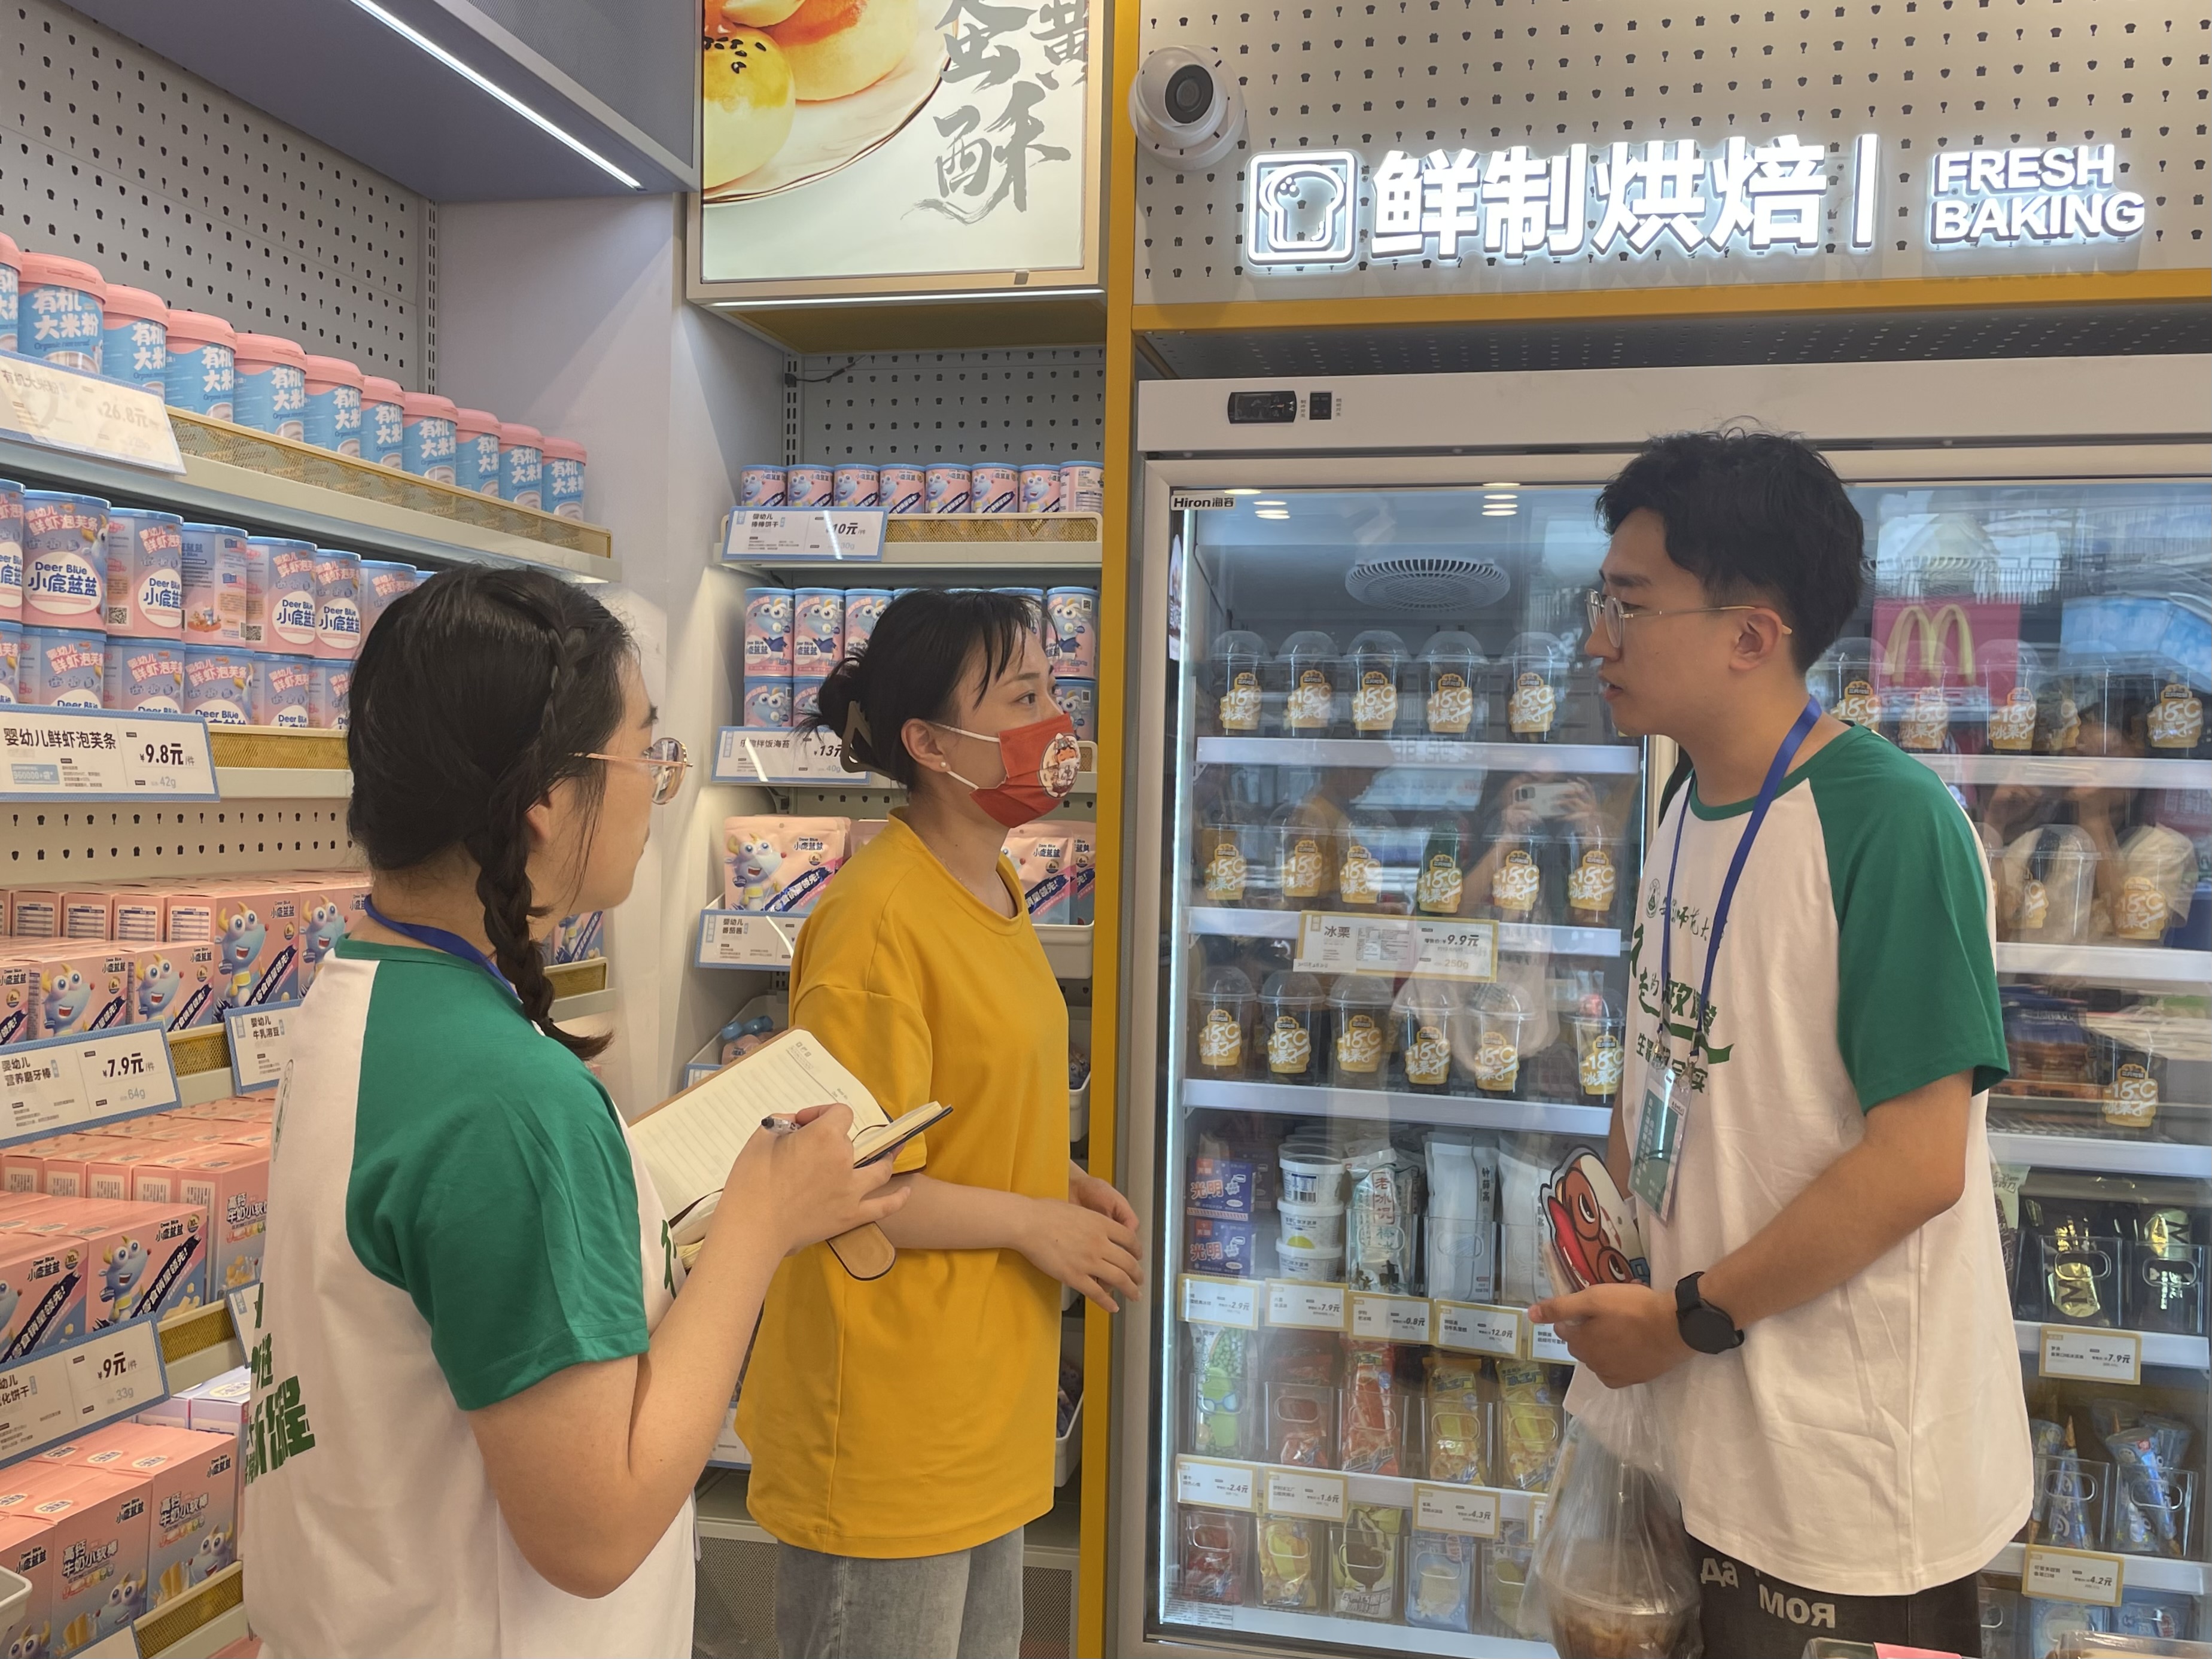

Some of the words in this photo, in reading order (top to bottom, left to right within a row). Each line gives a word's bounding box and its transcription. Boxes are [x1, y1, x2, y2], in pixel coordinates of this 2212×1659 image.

[900, 81, 1072, 226] 酥
[1933, 144, 2115, 196] FRESH
[1370, 136, 1827, 260] 鲜制烘焙
[1931, 192, 2146, 244] BAKING
[33, 289, 82, 313] 有机
[35, 312, 98, 340] 大米粉
[1173, 498, 1211, 507] Hiron
[25, 506, 57, 522] 婴幼儿
[29, 512, 98, 536] 鲜虾泡芙条
[35, 562, 63, 573] Deer
[66, 565, 87, 575] Blue
[28, 571, 97, 597] 小鹿蓝蓝
[150, 579, 168, 588] Deer
[282, 599, 300, 608] Deer
[324, 606, 342, 615] Deer
[190, 666, 247, 687] 鲜虾泡芙条
[195, 710, 219, 719] Deer
[222, 710, 239, 719] Blue
[278, 715, 297, 723] Deer
[4, 728, 116, 750] 婴幼儿鲜虾泡芙条
[160, 777, 176, 789] 42g
[794, 842, 824, 851] 小鹿蓝蓝
[270, 906, 294, 919] 小鹿蓝蓝
[1324, 926, 1350, 938] 冰栗
[190, 950, 212, 963] 小鹿蓝蓝
[1444, 959, 1469, 969] 250g
[102, 961, 126, 973] 小鹿蓝蓝
[251, 1016, 271, 1027] 婴幼儿
[253, 1027, 279, 1040] 牛乳溶豆
[1, 1057, 31, 1072] 婴幼儿
[5, 1068, 51, 1086] 营养磨牙棒
[127, 1088, 145, 1100] 64g
[1191, 1180, 1224, 1200] 光明
[156, 1223, 183, 1242] 小鹿蓝蓝
[1190, 1241, 1223, 1262] 光明
[28, 1261, 60, 1281] 小鹿蓝蓝
[116, 1387, 133, 1401] 33g
[206, 1457, 231, 1478] 小鹿蓝蓝
[116, 1499, 144, 1524] 小鹿蓝蓝
[159, 1493, 209, 1528] 牛奶小软棒
[160, 1491, 181, 1514] 高钙
[62, 1539, 118, 1578] 牛奶小软棒
[63, 1539, 87, 1563] 高钙
[16, 1548, 47, 1573] 小鹿蓝蓝
